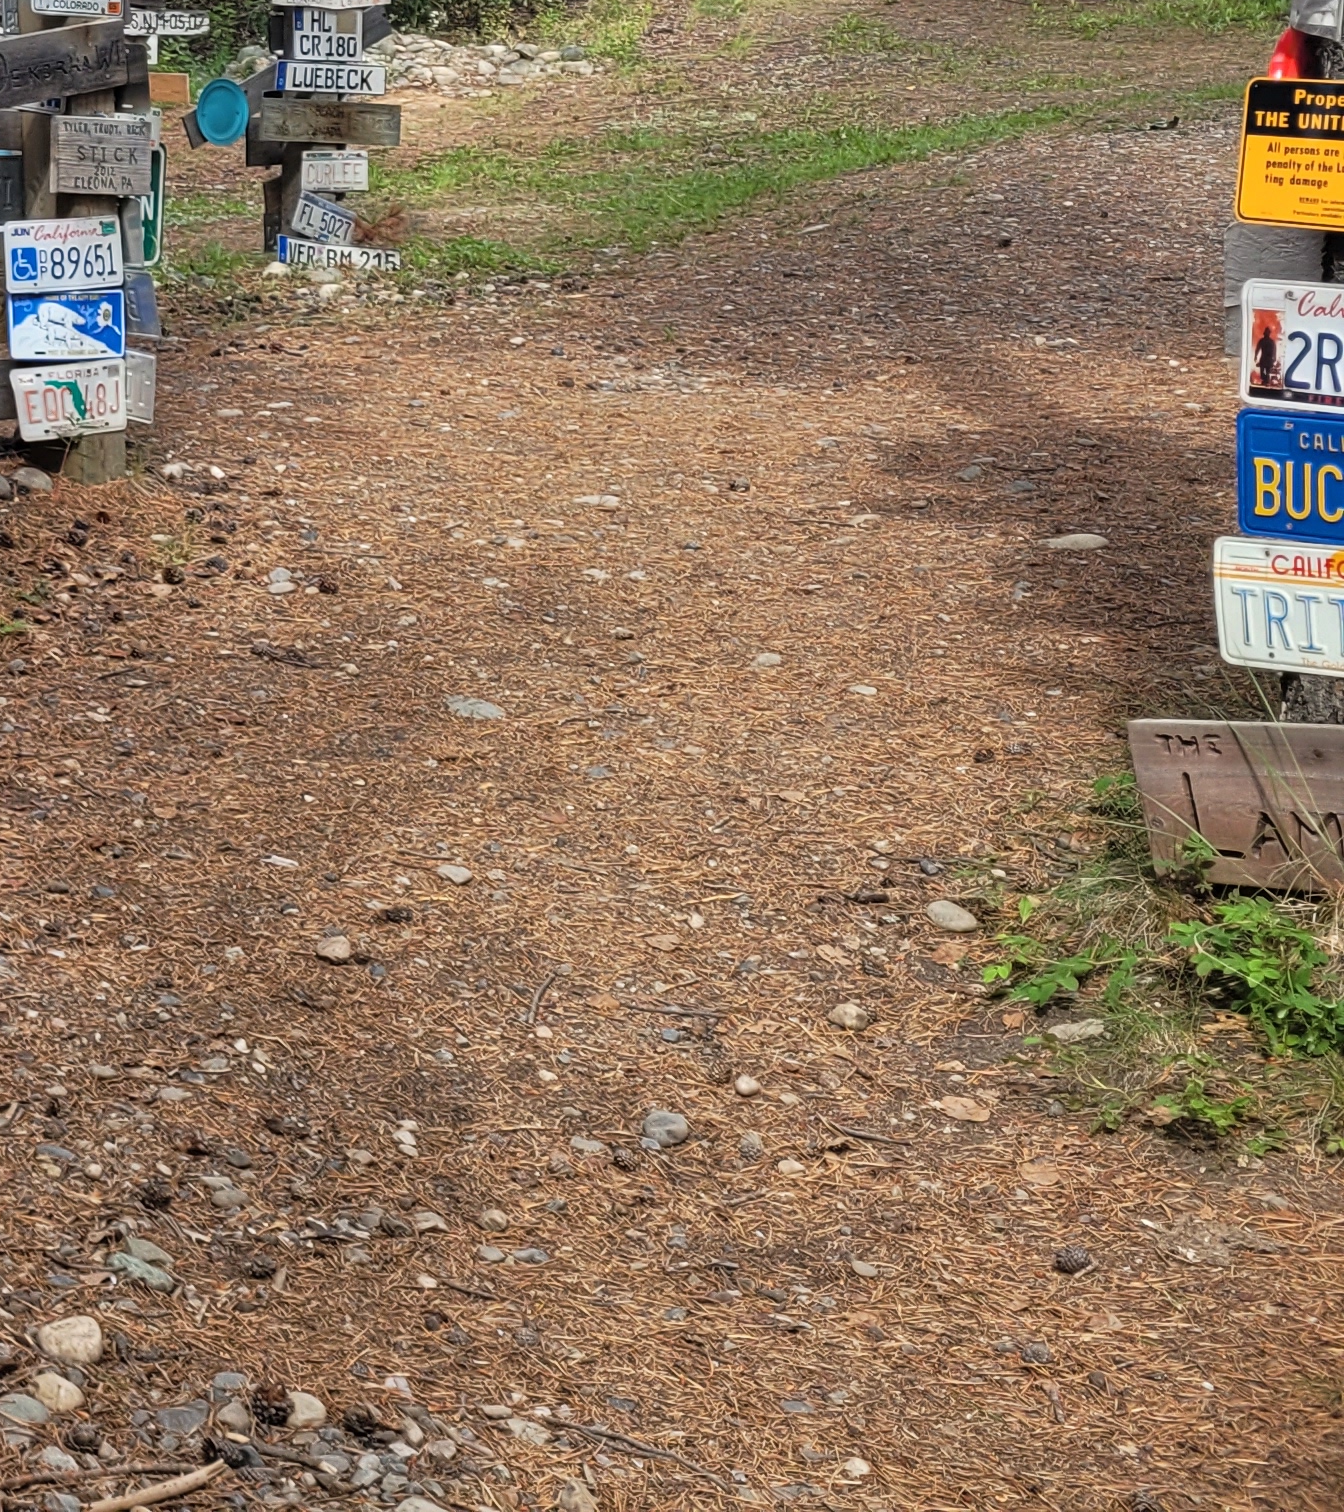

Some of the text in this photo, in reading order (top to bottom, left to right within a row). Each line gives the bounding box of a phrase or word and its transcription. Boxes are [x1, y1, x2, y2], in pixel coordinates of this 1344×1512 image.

[292, 67, 373, 91] LUEBECK
[1255, 111, 1289, 128] THE
[77, 145, 138, 164] STICK
[1267, 142, 1339, 157] All persons are
[1266, 160, 1333, 172] penalty of the
[1265, 174, 1328, 188] ting damage
[320, 211, 352, 240] 5027
[51, 244, 117, 279] 89651
